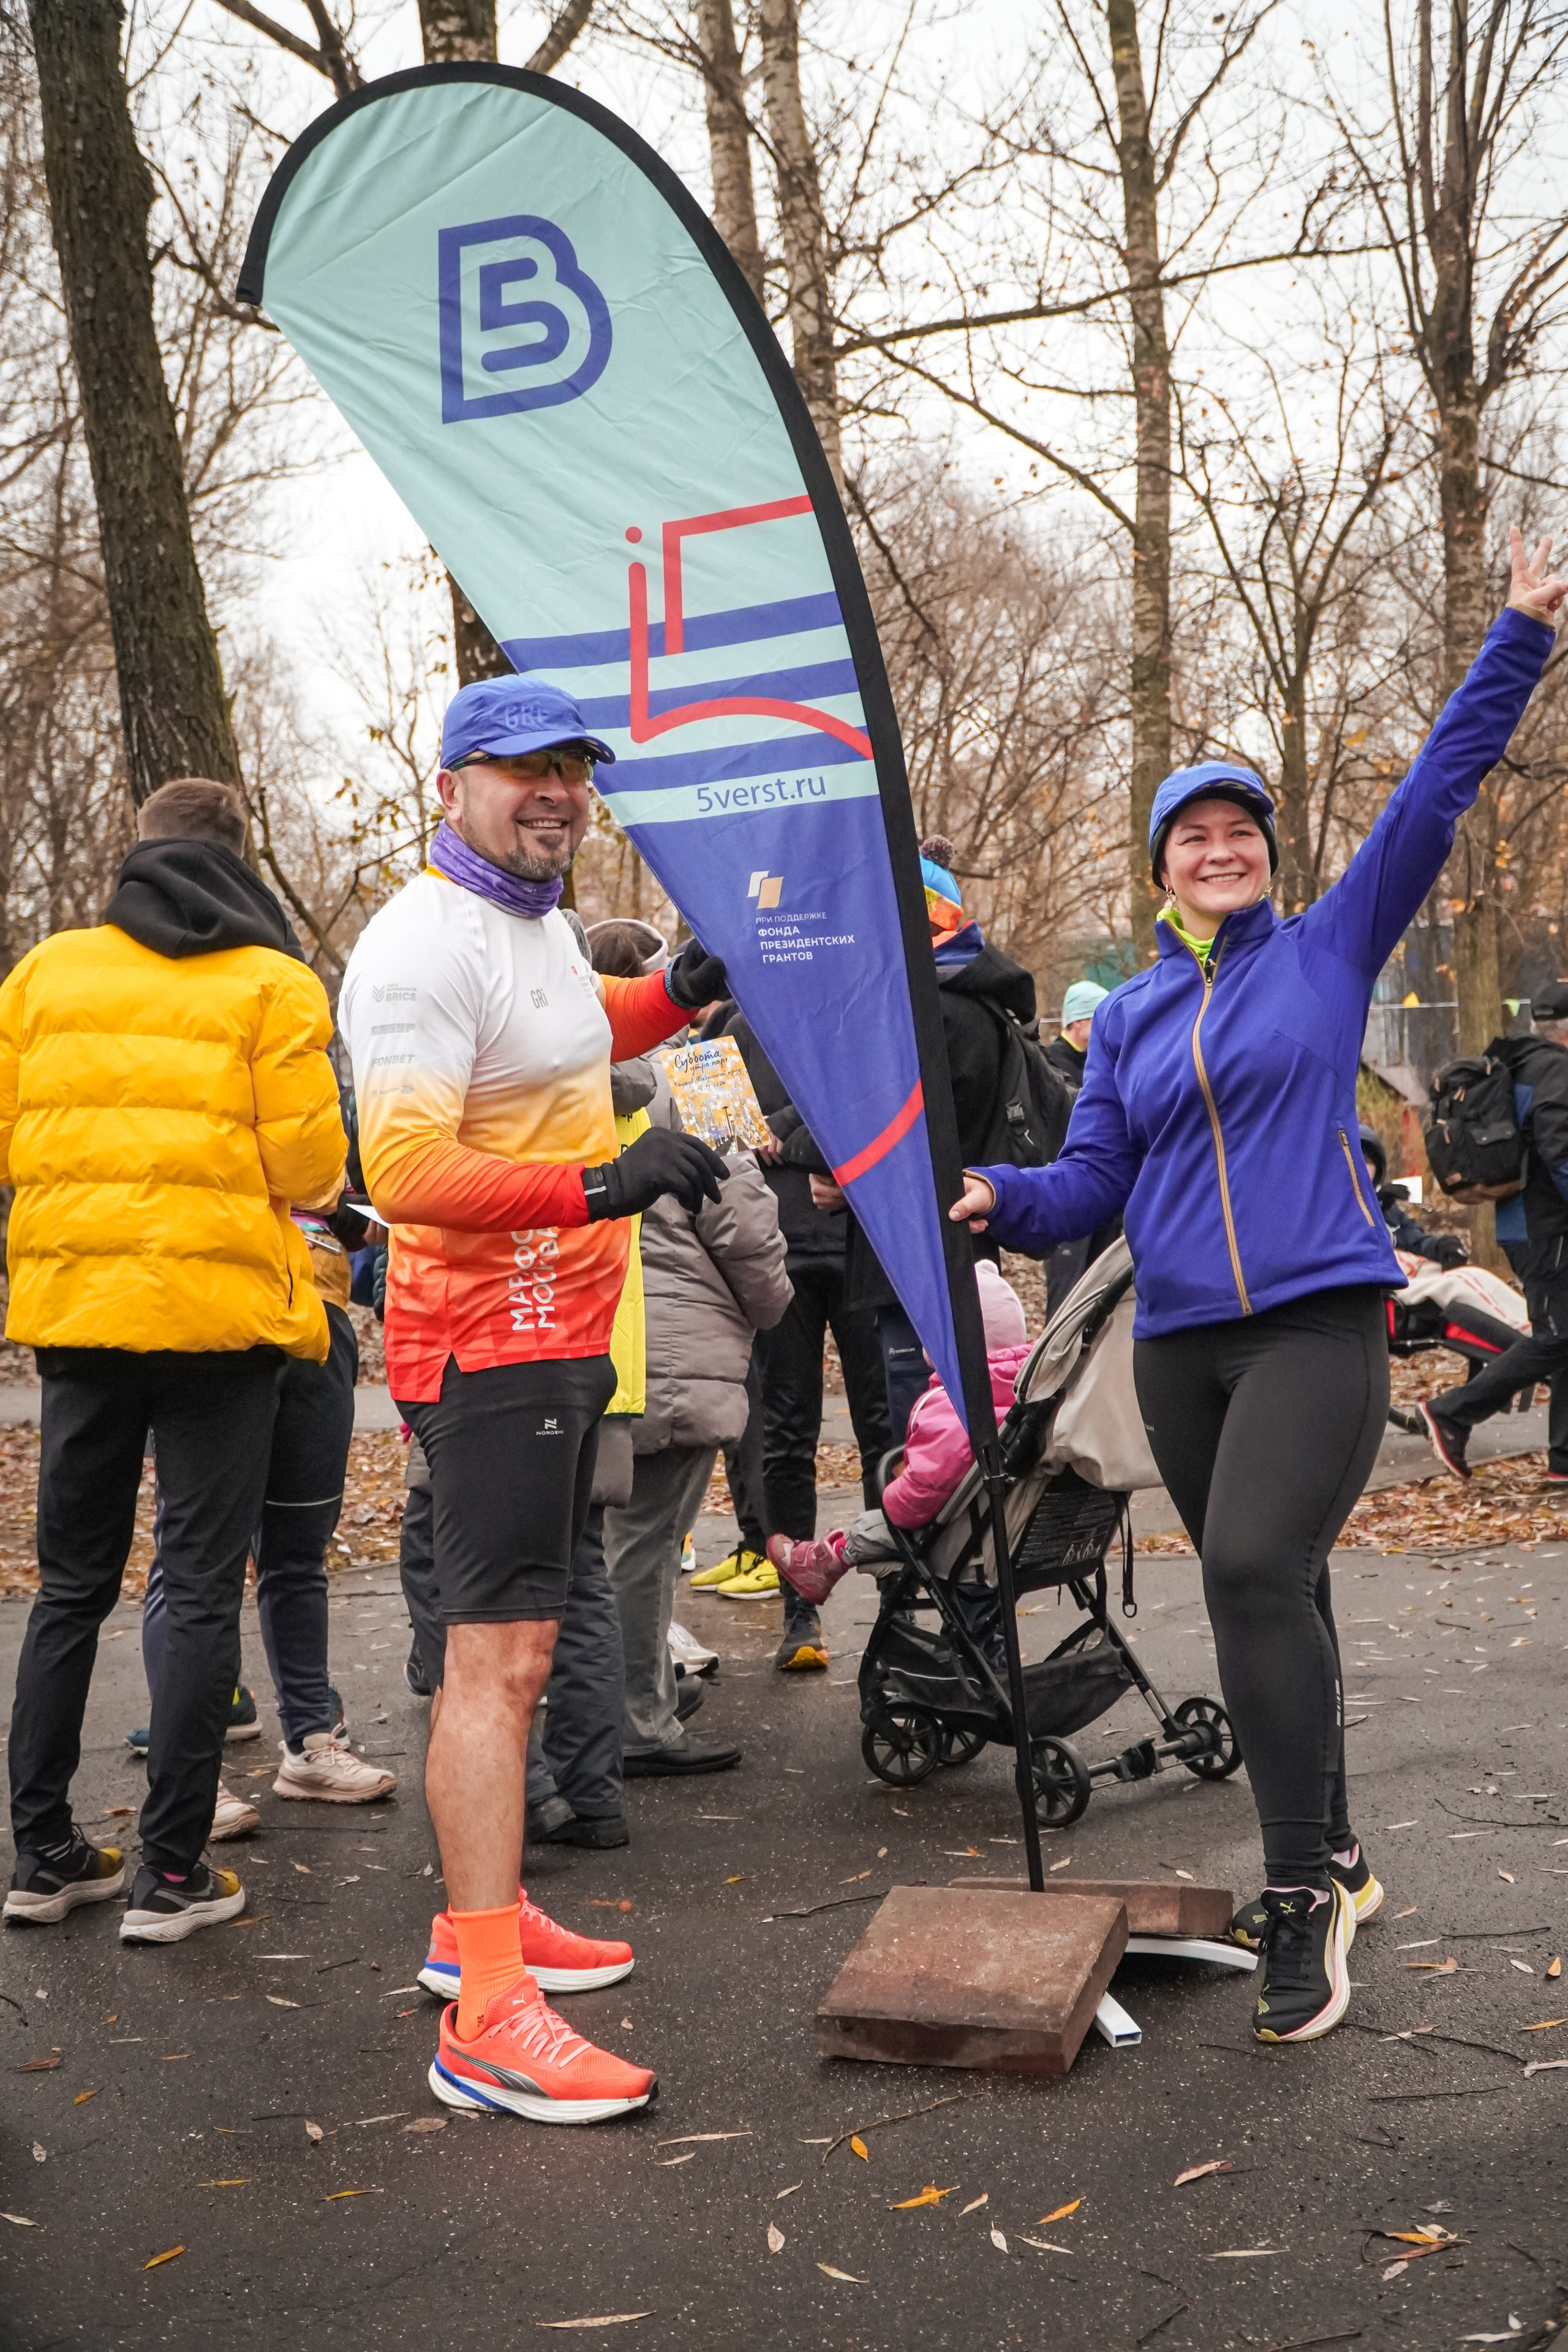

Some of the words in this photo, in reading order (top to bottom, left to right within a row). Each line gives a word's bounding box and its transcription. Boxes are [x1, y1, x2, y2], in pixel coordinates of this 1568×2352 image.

[697, 775, 827, 812] 5verst.ru
[774, 912, 827, 923] ПОДДЕРЖКЕ
[758, 925, 801, 937] ФОНДА
[760, 935, 855, 950] ПРЕЗИДЕНТСКИХ
[762, 951, 813, 963] ГРАНТОВ
[386, 992, 417, 1001] BRICS
[530, 988, 549, 1009] GRi
[371, 1054, 415, 1068] FONBET
[674, 1050, 722, 1073] Суббота
[690, 1063, 709, 1075] утро
[712, 1057, 729, 1069] парк
